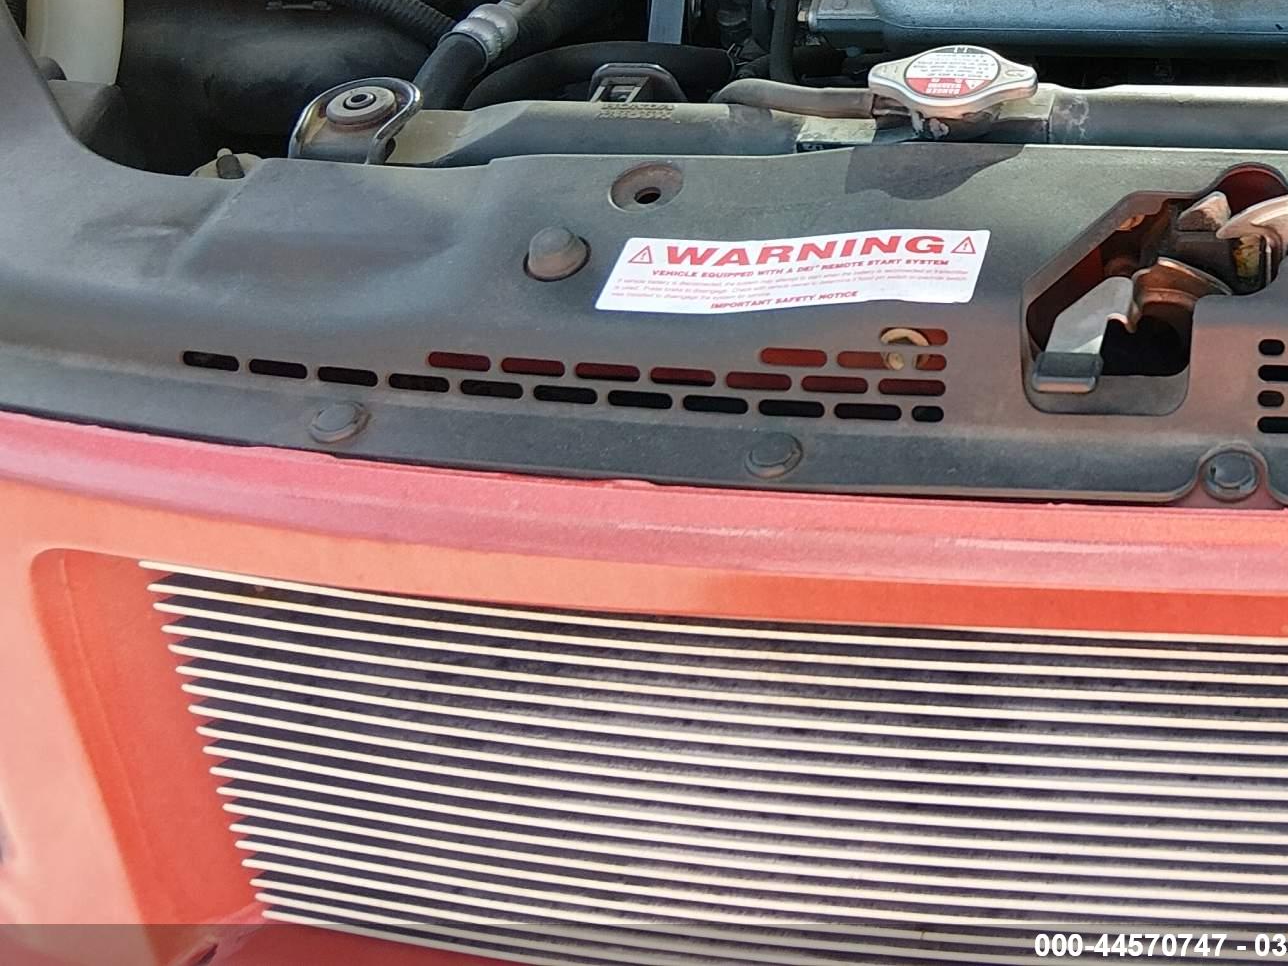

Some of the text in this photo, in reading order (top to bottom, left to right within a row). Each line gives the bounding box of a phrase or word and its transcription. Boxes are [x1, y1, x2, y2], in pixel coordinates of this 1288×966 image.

[667, 235, 945, 266] WARNING
[652, 269, 698, 277] VEHICLE
[701, 270, 753, 278] EQUIPPED
[757, 268, 784, 276] WITH
[821, 260, 864, 270] REMOTE
[867, 258, 902, 267] START
[710, 290, 859, 309] IMPORTANT SAFETY NOTICE
